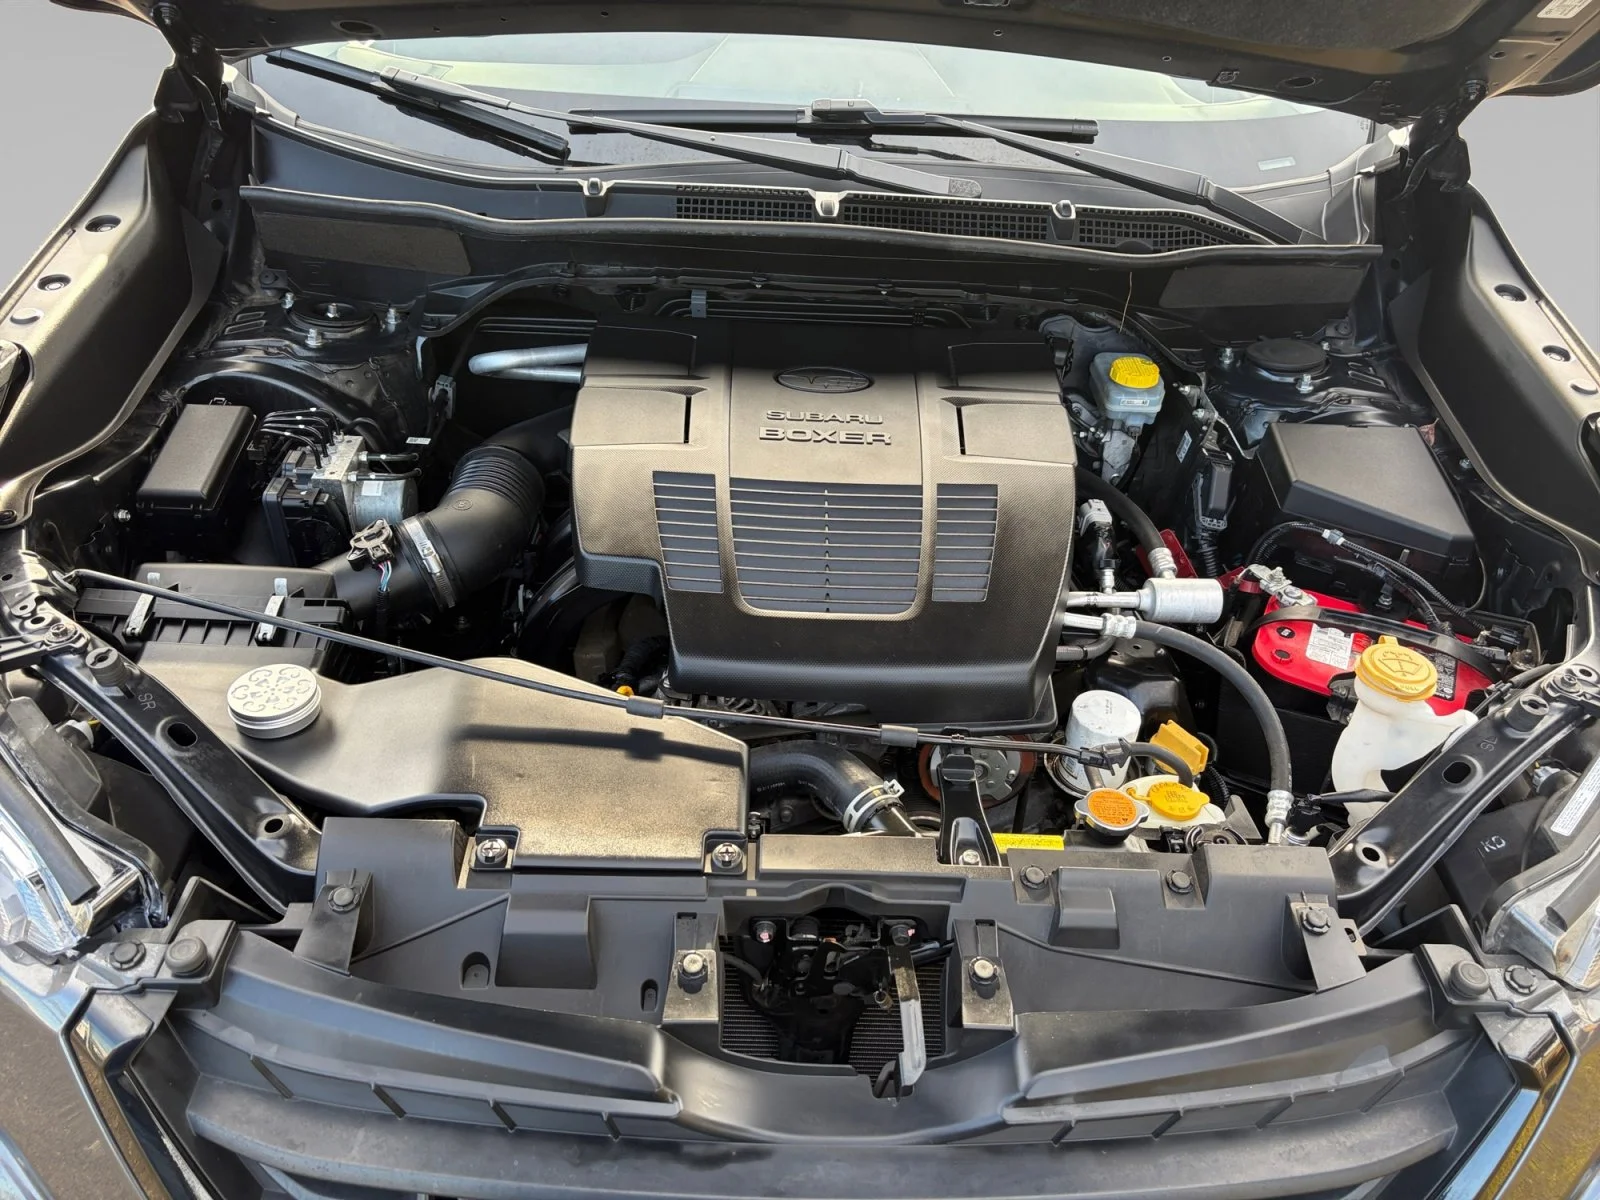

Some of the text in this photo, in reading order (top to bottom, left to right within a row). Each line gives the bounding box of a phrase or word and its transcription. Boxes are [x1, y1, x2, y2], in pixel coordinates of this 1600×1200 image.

[766, 409, 884, 425] SUBARU
[759, 426, 892, 445] BOXER
[137, 692, 156, 711] SR
